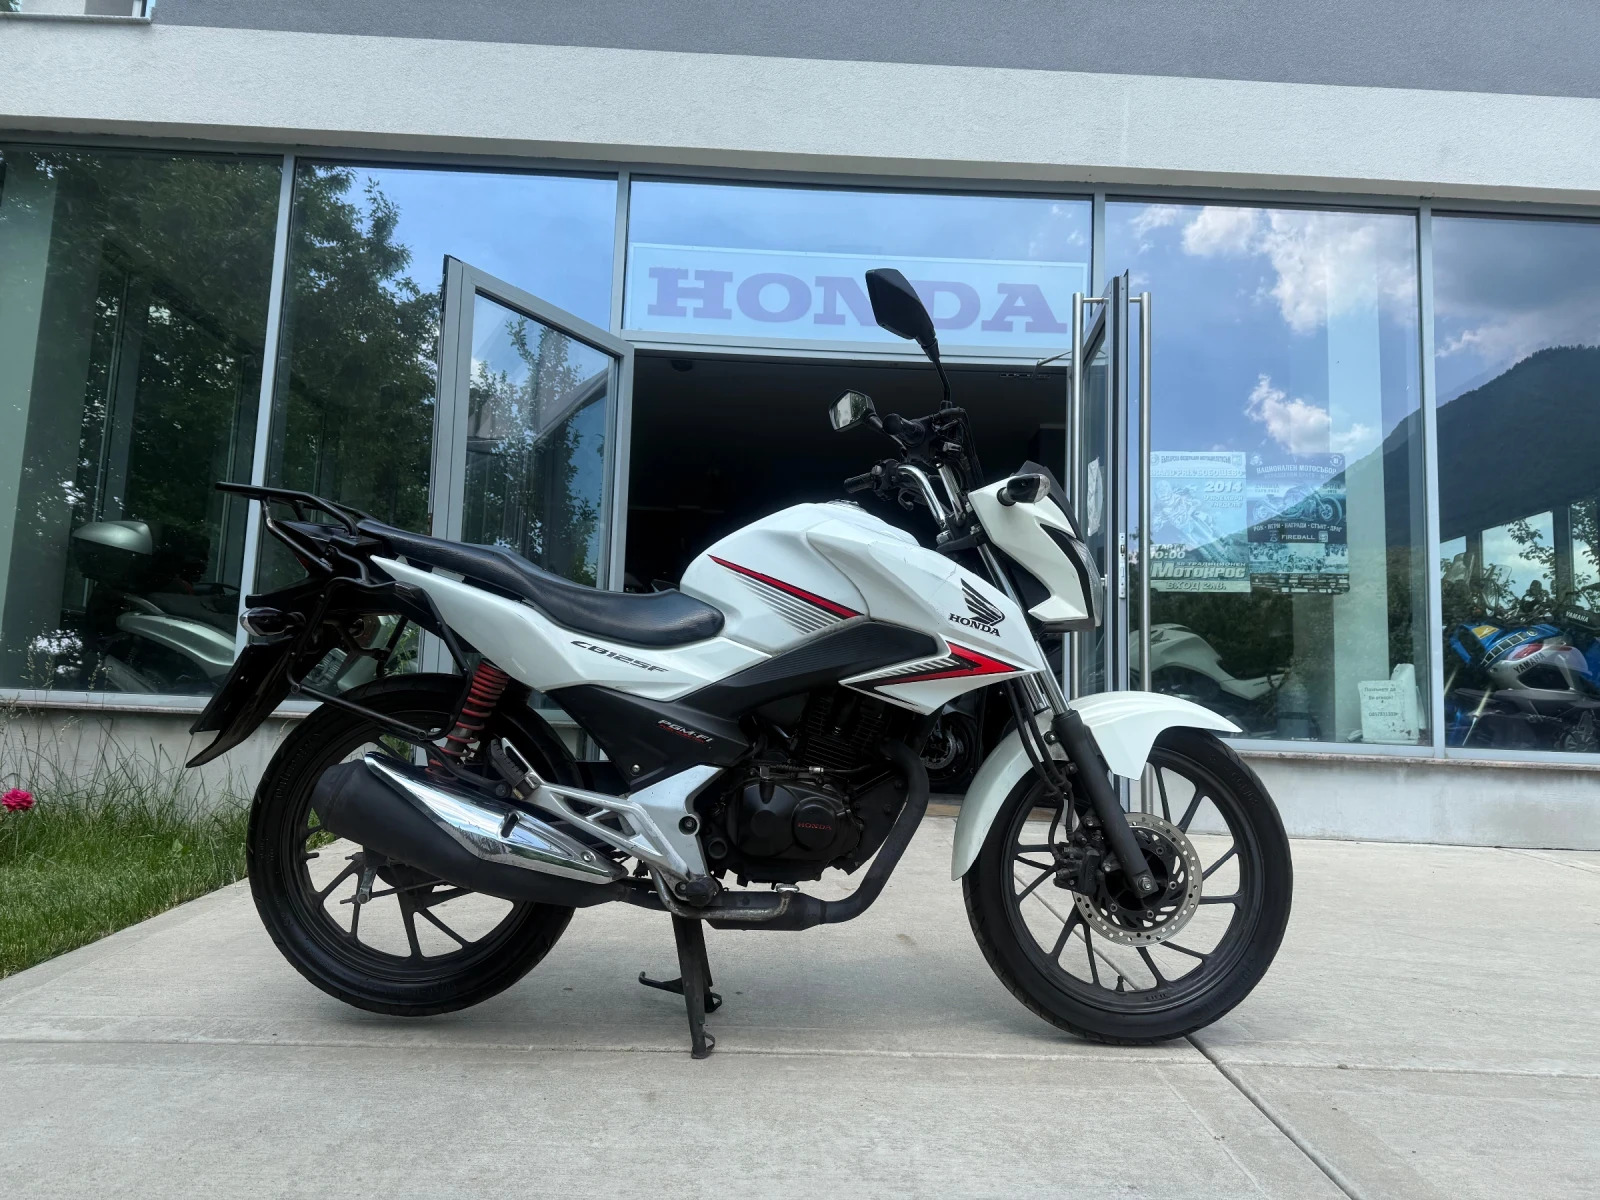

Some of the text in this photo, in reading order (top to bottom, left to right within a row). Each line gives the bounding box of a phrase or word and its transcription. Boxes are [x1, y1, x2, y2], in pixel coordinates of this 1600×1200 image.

[647, 267, 1068, 335] HONDA
[1256, 464, 1337, 475] НАЦИОНАЛЕН МОТОСЪБОР
[1204, 481, 1244, 493] 2014
[1166, 581, 1200, 591] ВХОД
[949, 613, 1001, 637] HONDA
[1566, 611, 1588, 622] YAMAHA
[570, 640, 669, 673] CB125F
[1513, 652, 1546, 674] YAMAHA
[657, 719, 713, 742] PGM-FI
[797, 822, 832, 831] HONDA
